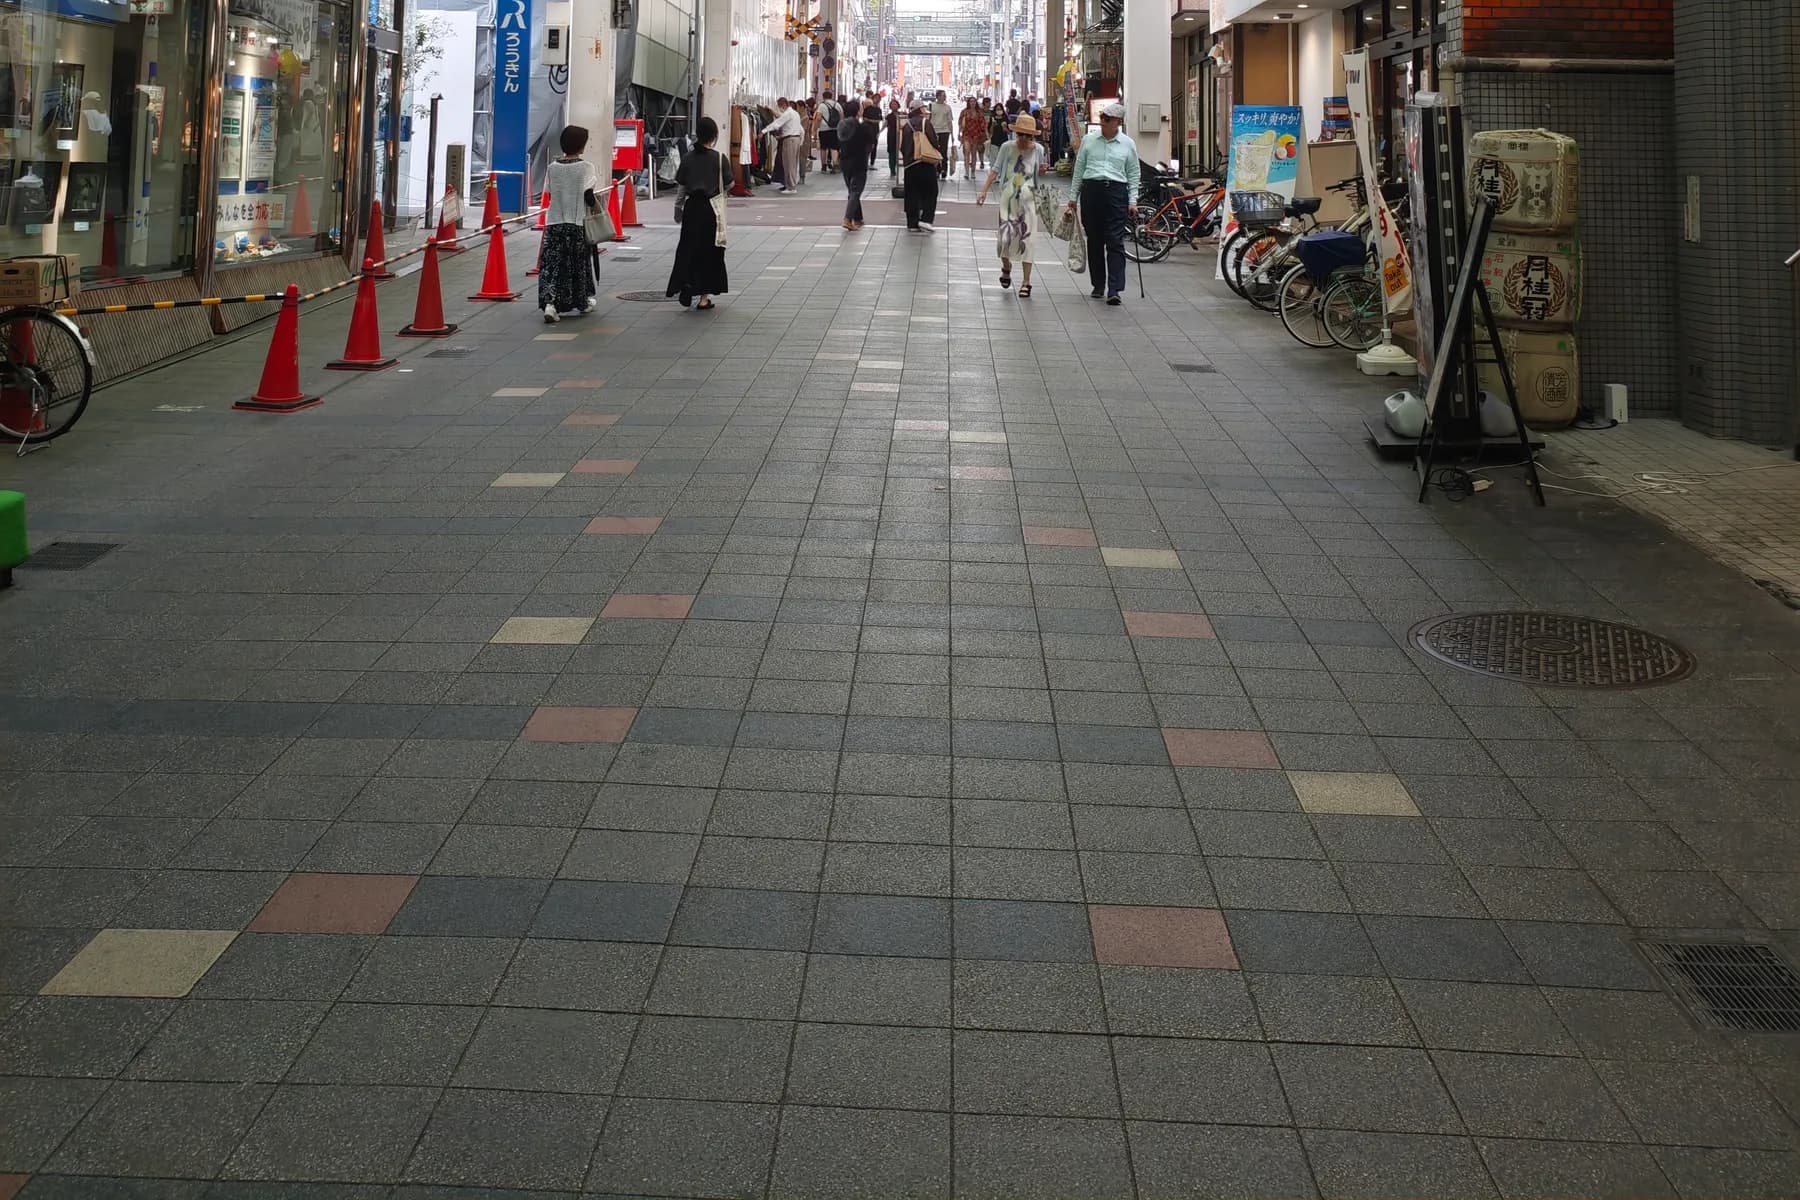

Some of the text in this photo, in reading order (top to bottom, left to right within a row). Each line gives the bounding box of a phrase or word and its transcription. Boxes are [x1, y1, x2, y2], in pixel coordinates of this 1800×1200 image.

[503, 32, 521, 94] ろうきん
[1520, 254, 1551, 321] 月桂冠
